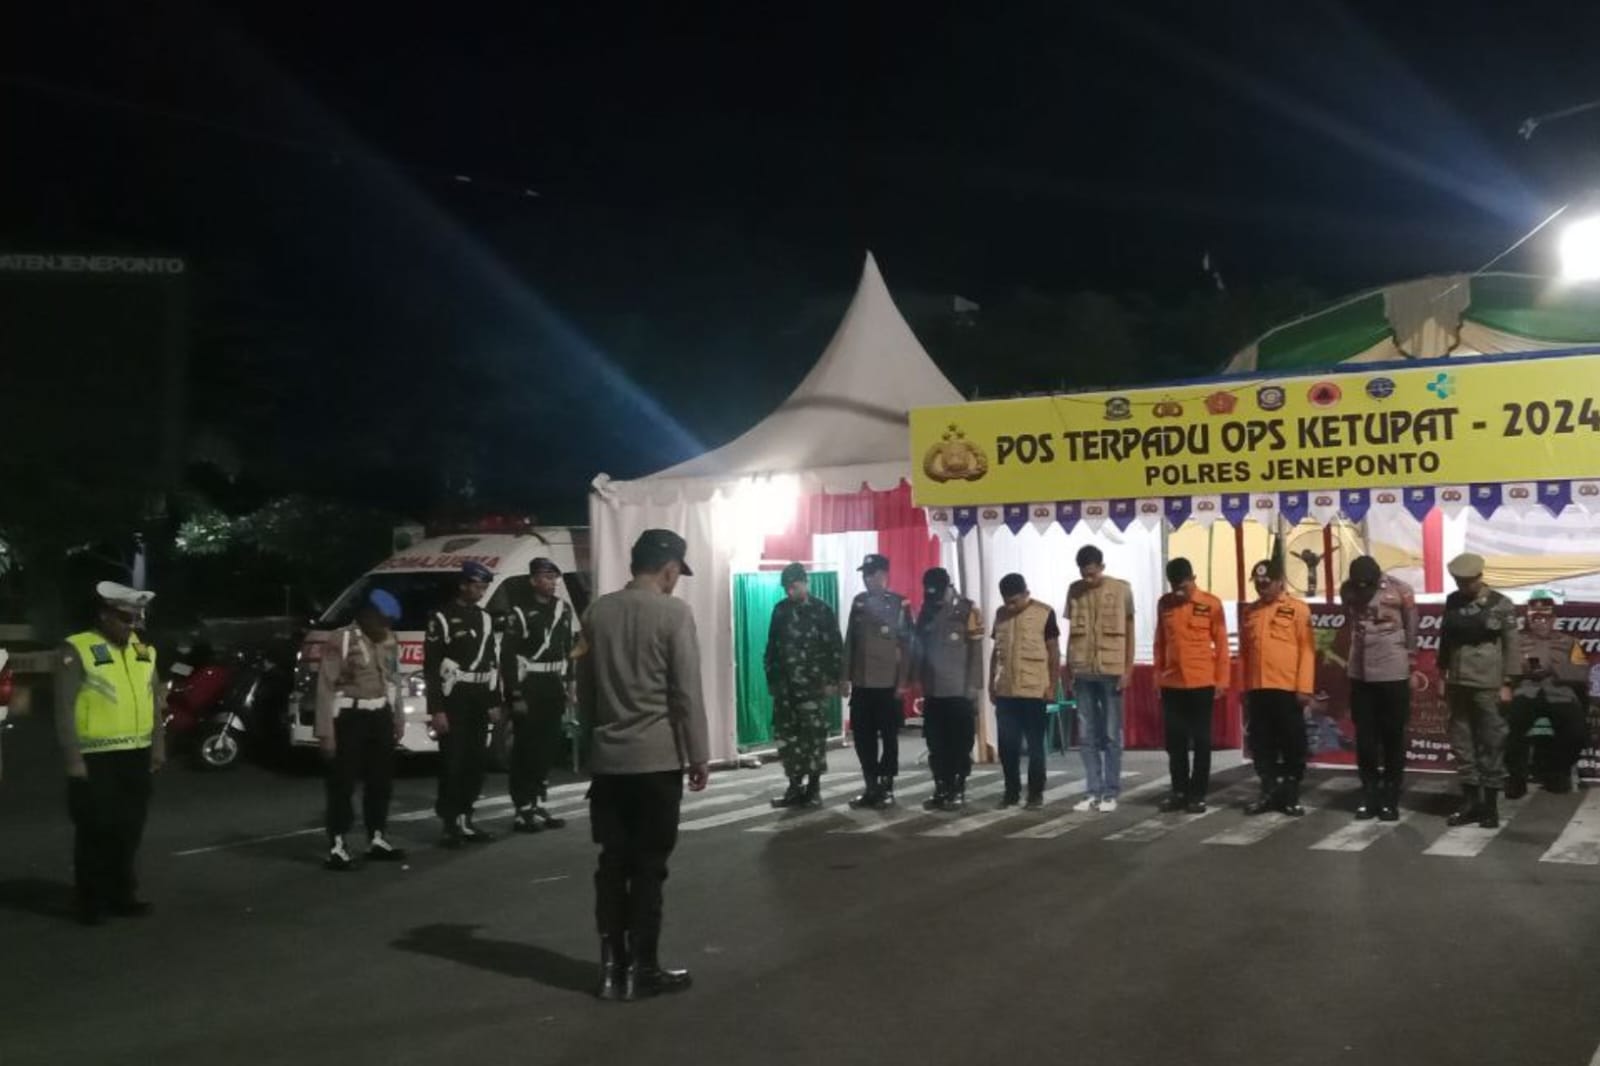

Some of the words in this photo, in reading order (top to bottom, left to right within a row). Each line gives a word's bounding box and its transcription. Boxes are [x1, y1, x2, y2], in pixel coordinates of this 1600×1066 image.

[996, 433, 1055, 465] POS
[1063, 422, 1210, 463] TERPADU
[1220, 418, 1286, 453] OPS
[1297, 407, 1459, 449] KETUPAT
[1502, 397, 1600, 437] 2024
[1145, 460, 1251, 486] POLRES
[1260, 451, 1440, 481] JENEPONTO
[1311, 613, 1346, 628] SKO
